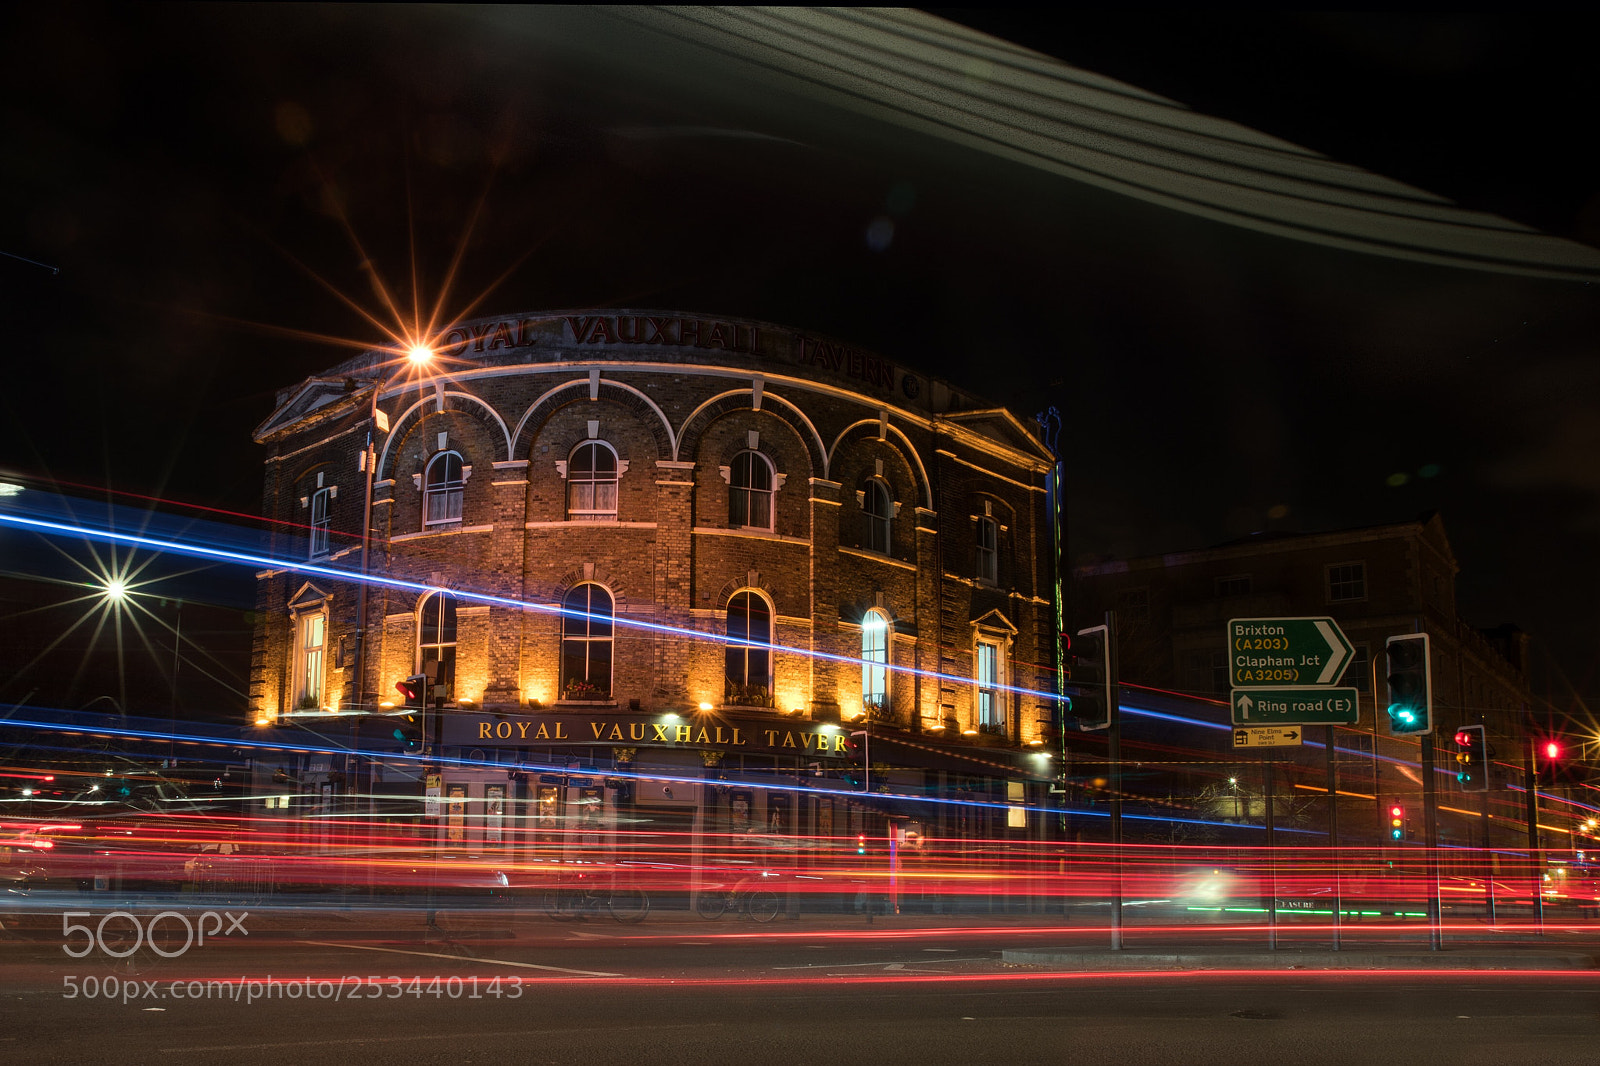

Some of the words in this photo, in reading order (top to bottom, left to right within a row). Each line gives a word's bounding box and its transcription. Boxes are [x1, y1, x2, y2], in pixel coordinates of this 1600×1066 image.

[441, 319, 536, 356] OYAL
[565, 315, 767, 356] VAUXHALL
[795, 333, 896, 391] TAVERN
[1235, 625, 1285, 636] Brixton
[1236, 655, 1295, 669] Clapham
[1299, 655, 1320, 666] Jct
[1257, 700, 1287, 713] Ring
[1292, 699, 1323, 711] road
[1326, 698, 1352, 713] (E)
[478, 721, 569, 740] ROYAL
[591, 722, 746, 746] VAUXHALL
[764, 729, 849, 753] TAVER
